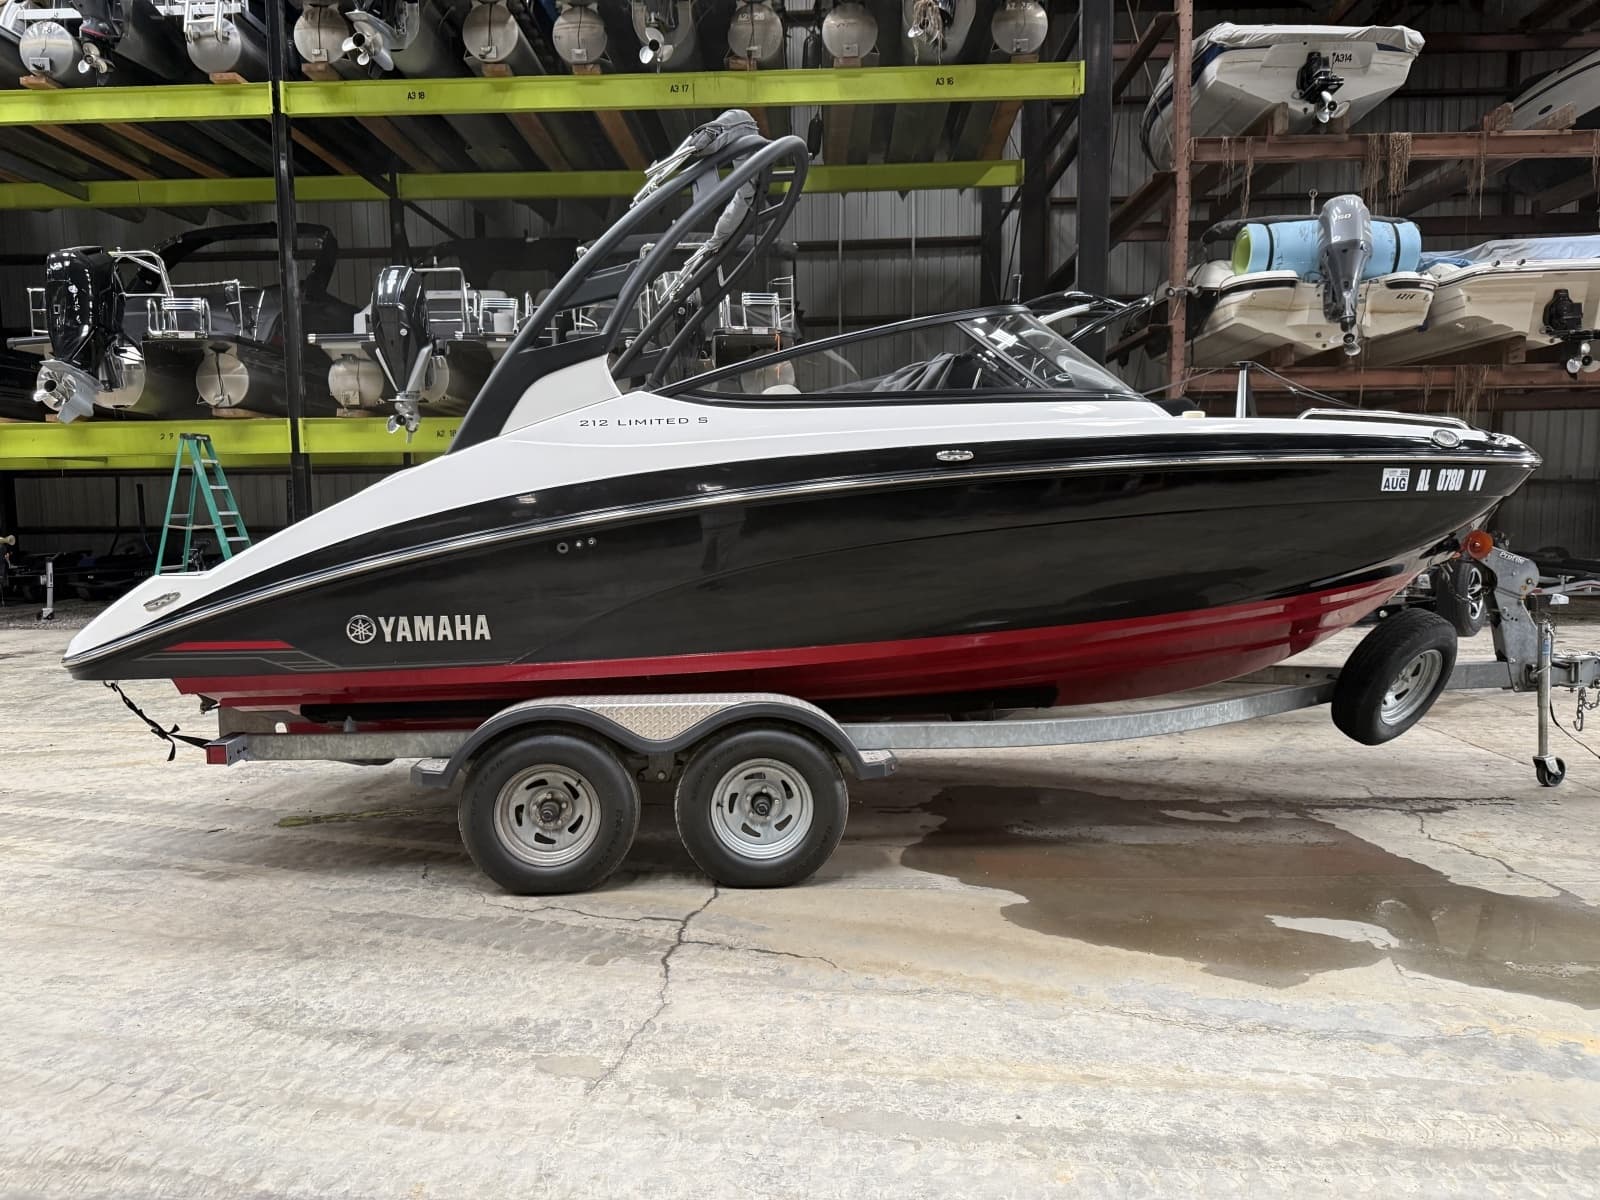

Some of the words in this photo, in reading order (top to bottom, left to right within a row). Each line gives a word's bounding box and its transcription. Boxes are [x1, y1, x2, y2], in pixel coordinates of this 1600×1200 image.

[579, 419, 608, 427] 212
[617, 417, 689, 426] LIMITED
[697, 416, 708, 424] S
[1383, 477, 1407, 490] AUG
[1415, 468, 1432, 491] AL
[377, 614, 491, 642] YAMAHA
